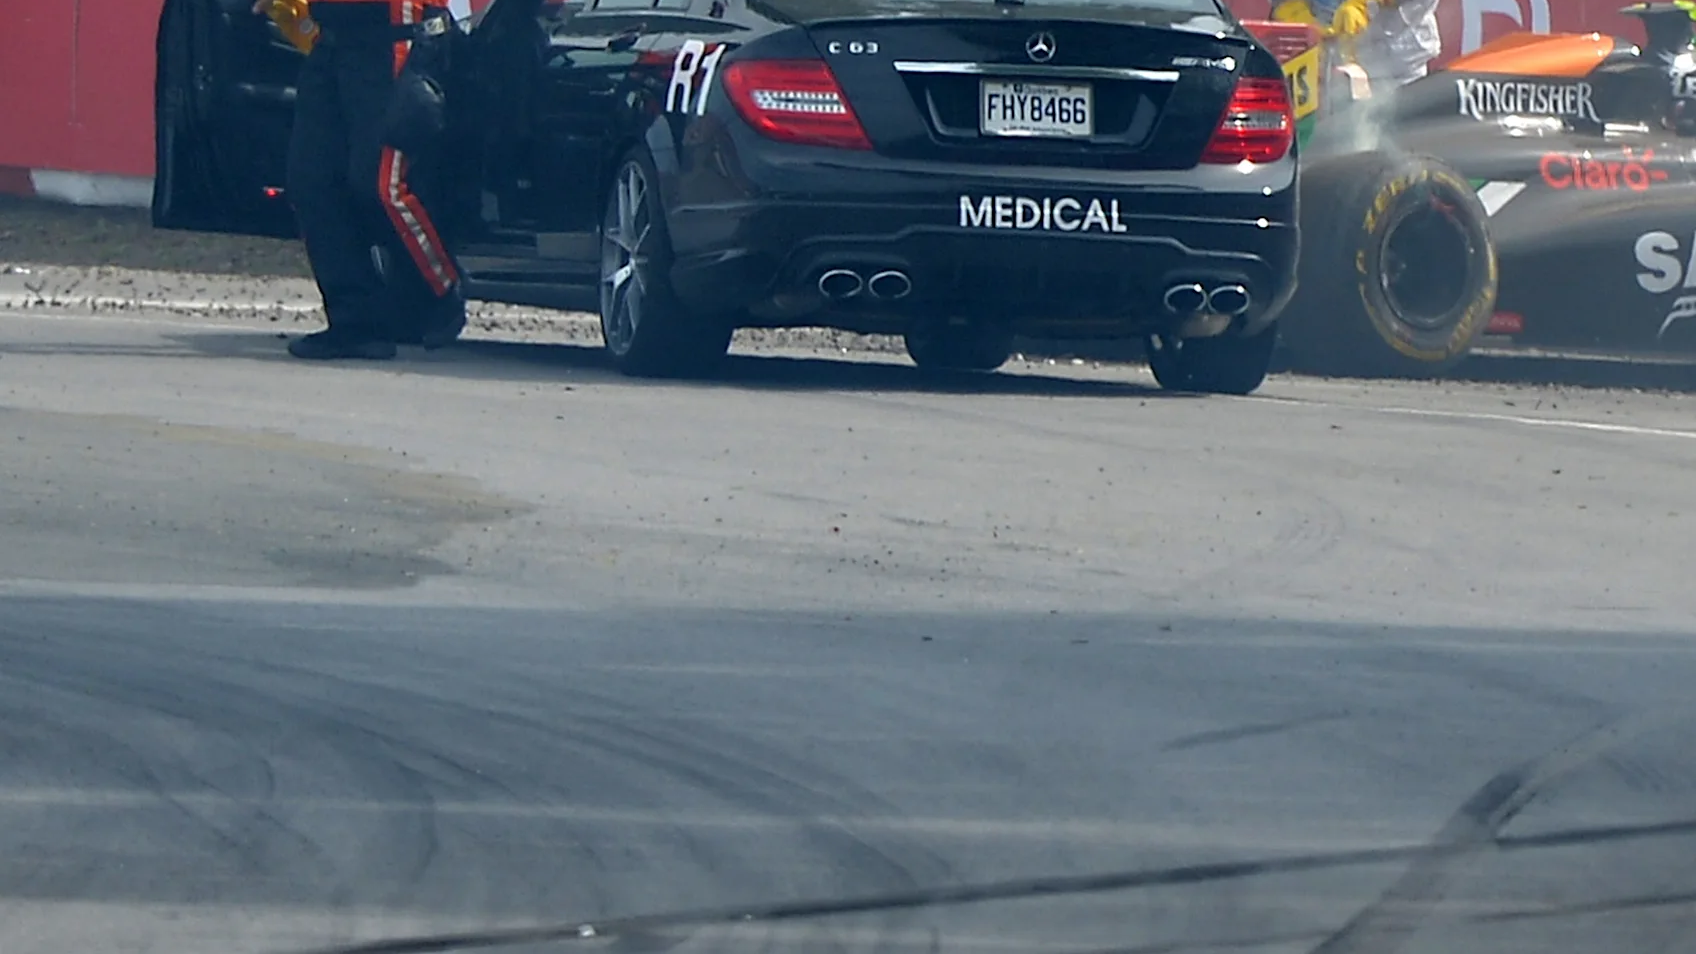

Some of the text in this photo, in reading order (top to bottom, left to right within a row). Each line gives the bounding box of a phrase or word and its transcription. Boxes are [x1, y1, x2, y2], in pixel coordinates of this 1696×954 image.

[828, 42, 879, 54] C 63
[666, 39, 726, 116] R1
[987, 93, 1086, 124] FHY8466
[1456, 78, 1601, 123] KINGFISHER
[959, 195, 1128, 233] MEDICAL
